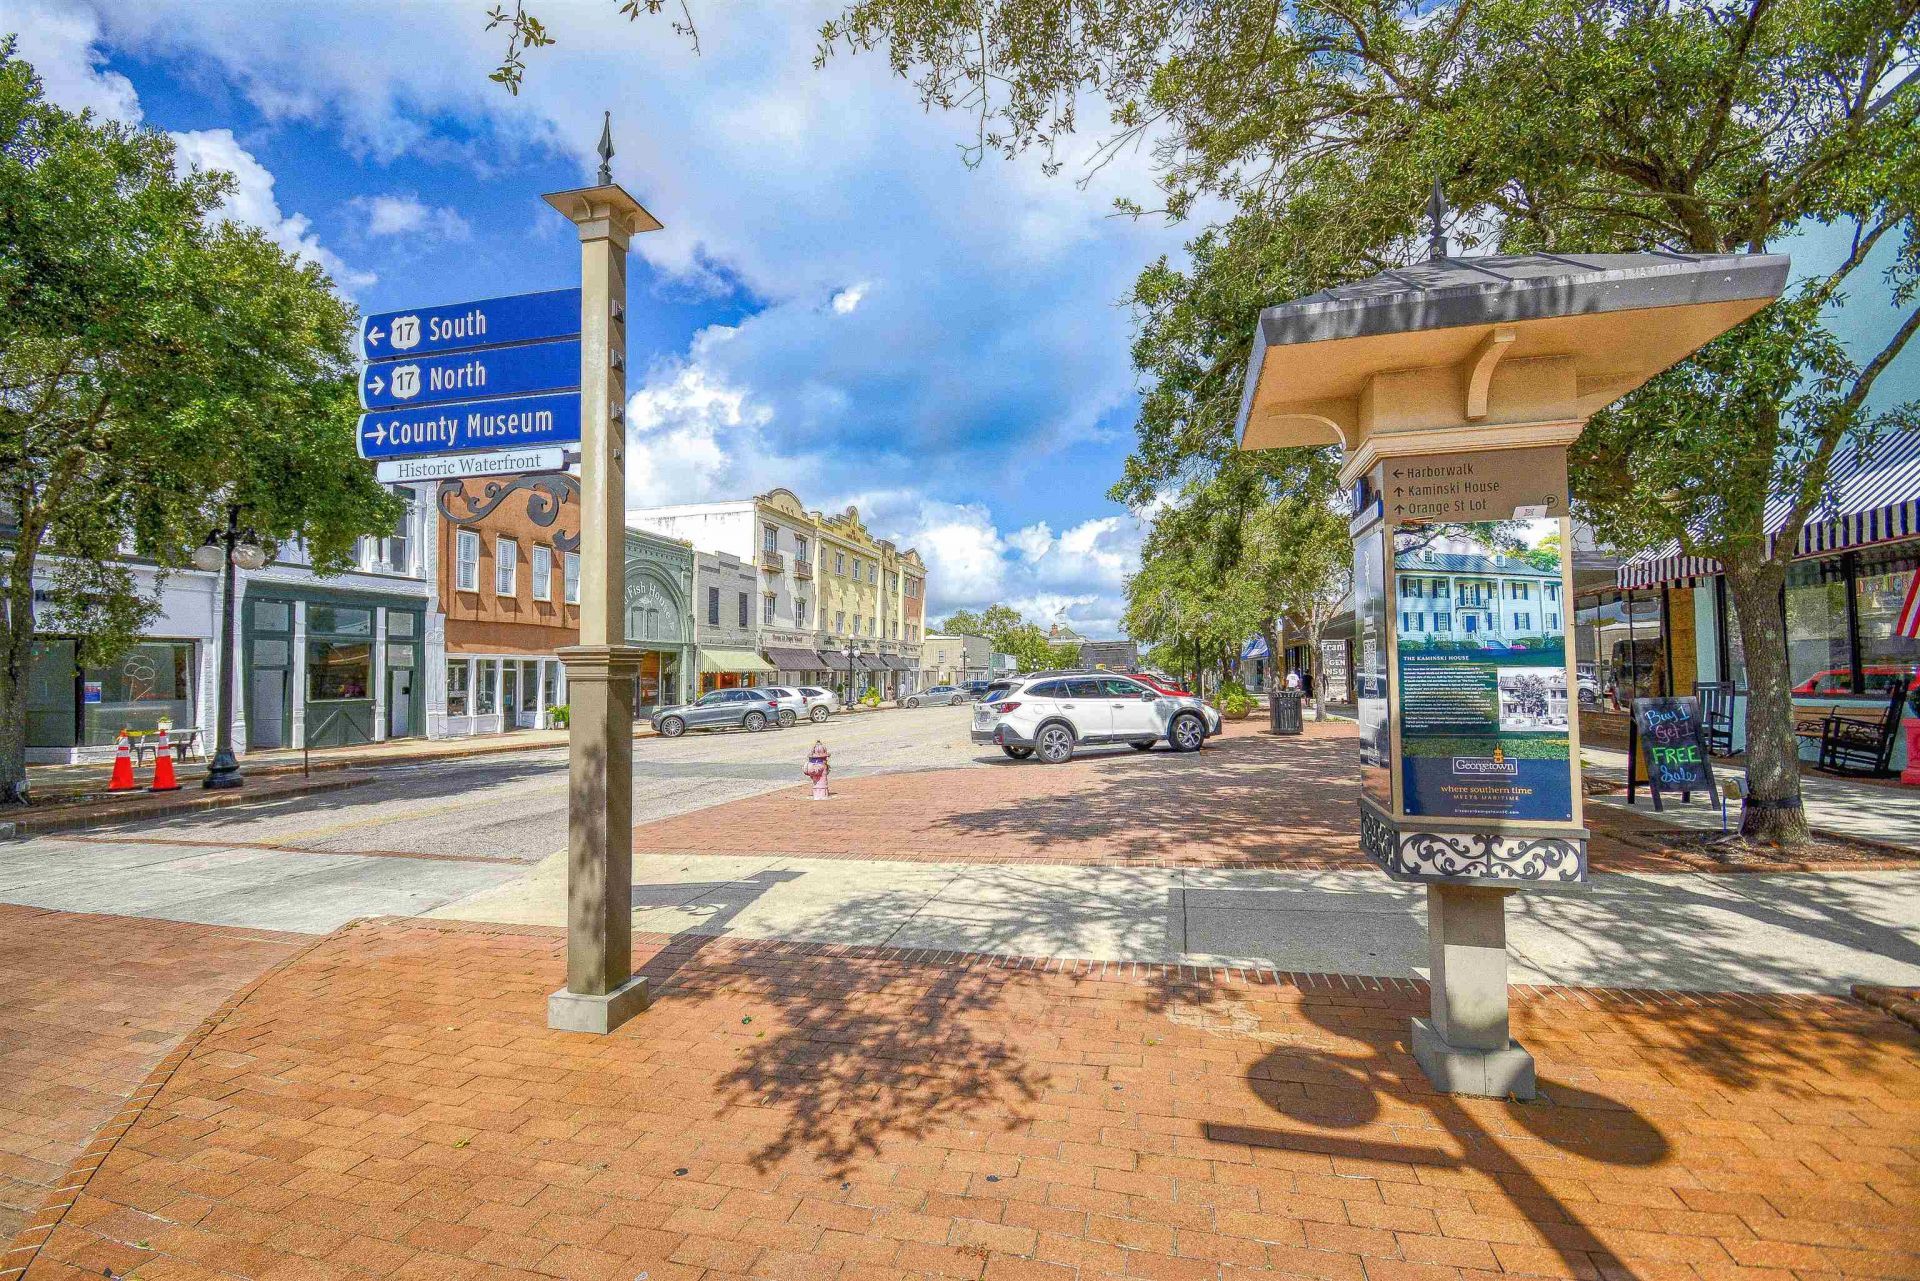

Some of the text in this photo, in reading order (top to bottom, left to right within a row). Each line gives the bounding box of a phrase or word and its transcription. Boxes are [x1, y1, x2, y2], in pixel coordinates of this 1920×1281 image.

[396, 309, 487, 342] 17 South
[396, 360, 487, 391] 17 North
[389, 410, 552, 446] County Museum
[398, 454, 542, 478] Historic Waterfront
[1407, 463, 1474, 479] Harborwalk
[1408, 481, 1500, 497] Kaminski House
[1408, 499, 1487, 515] Orange St Lot
[627, 581, 671, 619] Fish House
[1645, 709, 1678, 726] Buy
[1655, 722, 1680, 743] Get
[1652, 745, 1702, 765] FREE
[1455, 759, 1514, 773] Georgetown
[1660, 764, 1697, 783] Sale
[1440, 785, 1533, 795] where southern time
